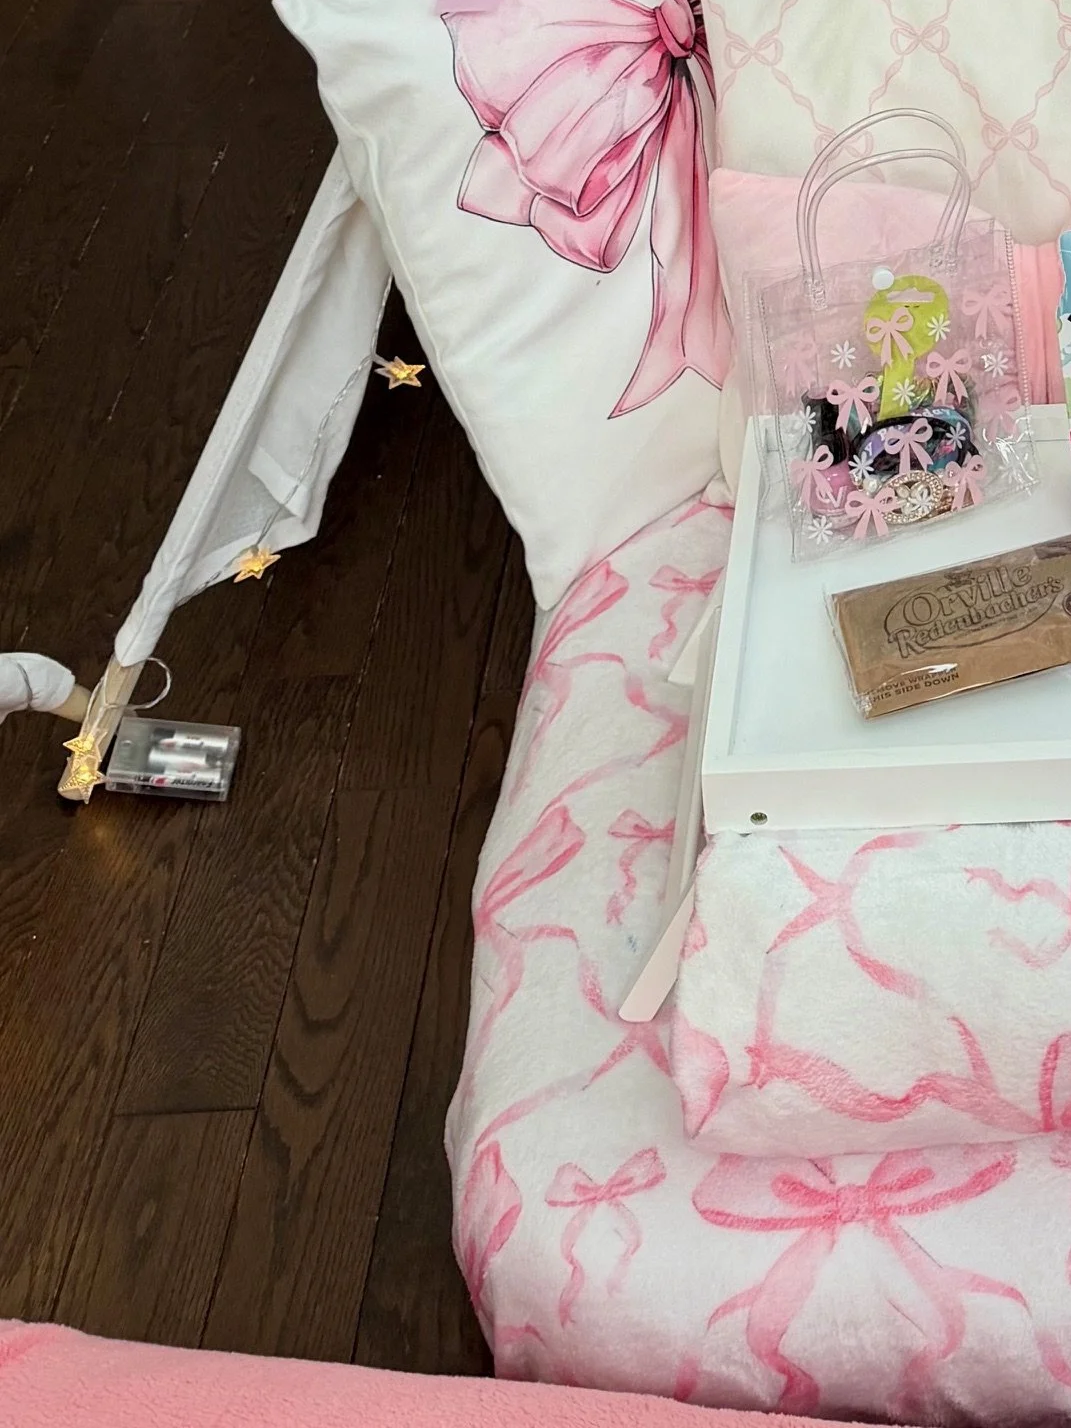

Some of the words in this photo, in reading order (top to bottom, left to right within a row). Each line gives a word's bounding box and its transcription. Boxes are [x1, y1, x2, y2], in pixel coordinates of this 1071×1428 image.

[893, 576, 1064, 658] Redenbacher's
[903, 565, 1032, 626] Orville
[894, 683, 922, 695] SIDE
[924, 672, 960, 688] DOWN
